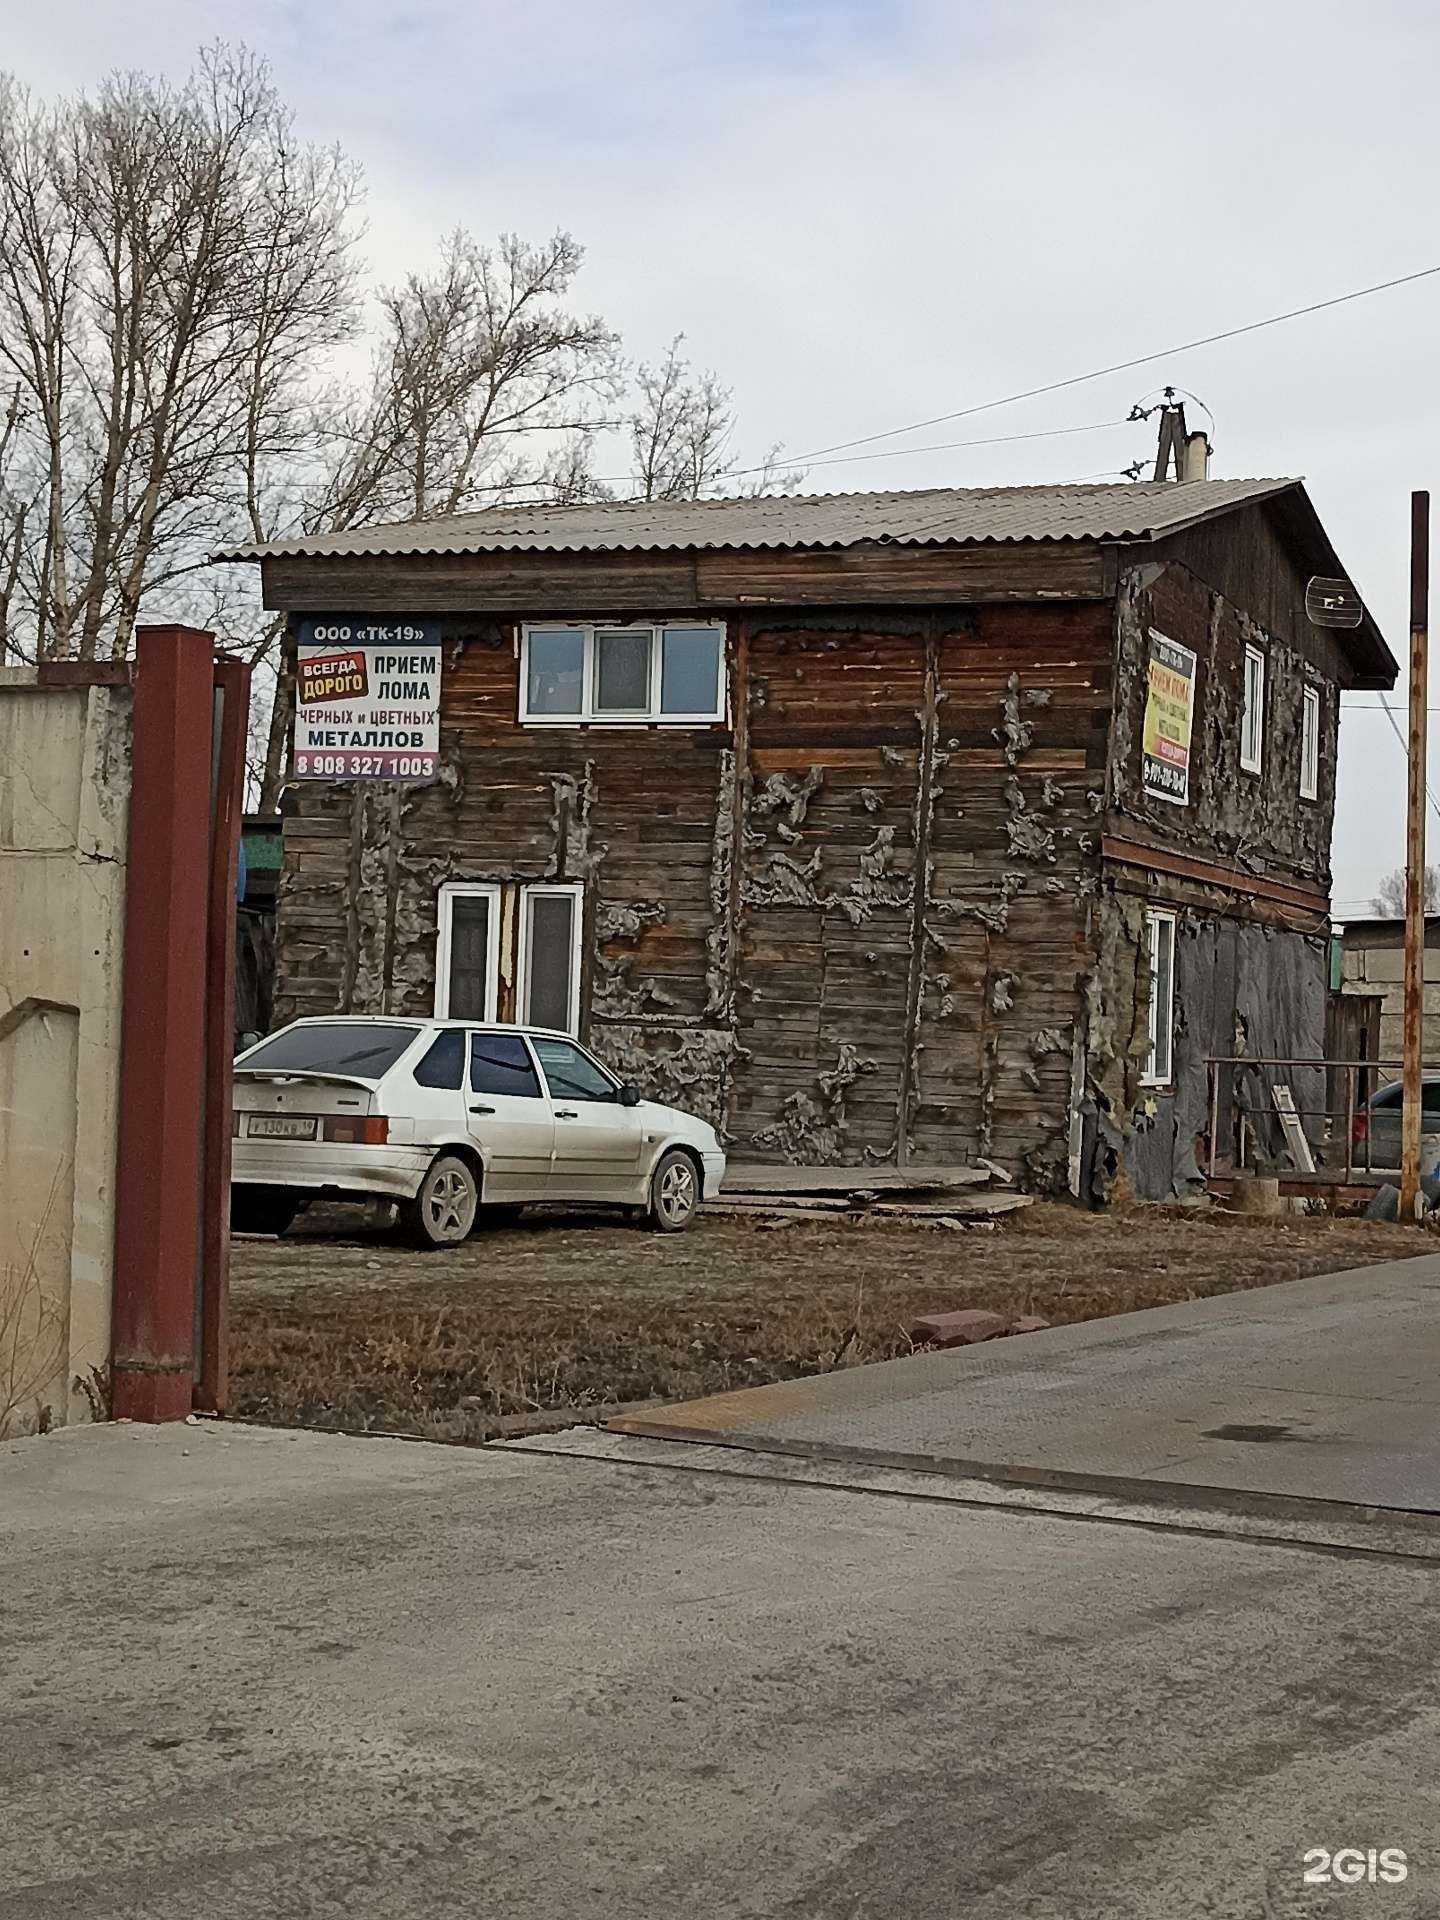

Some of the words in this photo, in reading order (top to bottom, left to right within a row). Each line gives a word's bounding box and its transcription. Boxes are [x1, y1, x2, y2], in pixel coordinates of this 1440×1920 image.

[314, 626, 351, 641] ООО
[356, 626, 424, 641] «ТК-19»
[303, 659, 358, 677] ВСЕГДА
[374, 656, 436, 675] ПРИЕМ
[303, 674, 363, 700] ДОРОГО
[377, 681, 431, 700] ЛОМА
[300, 710, 353, 725] ЧЕРНЫХ
[370, 710, 434, 727] ЦВЕТНЫХ
[308, 731, 424, 748] МЕТАЛЛОВ
[298, 757, 308, 774] 8
[313, 757, 345, 775] 908
[350, 757, 384, 776] 327
[389, 758, 434, 777] 1003
